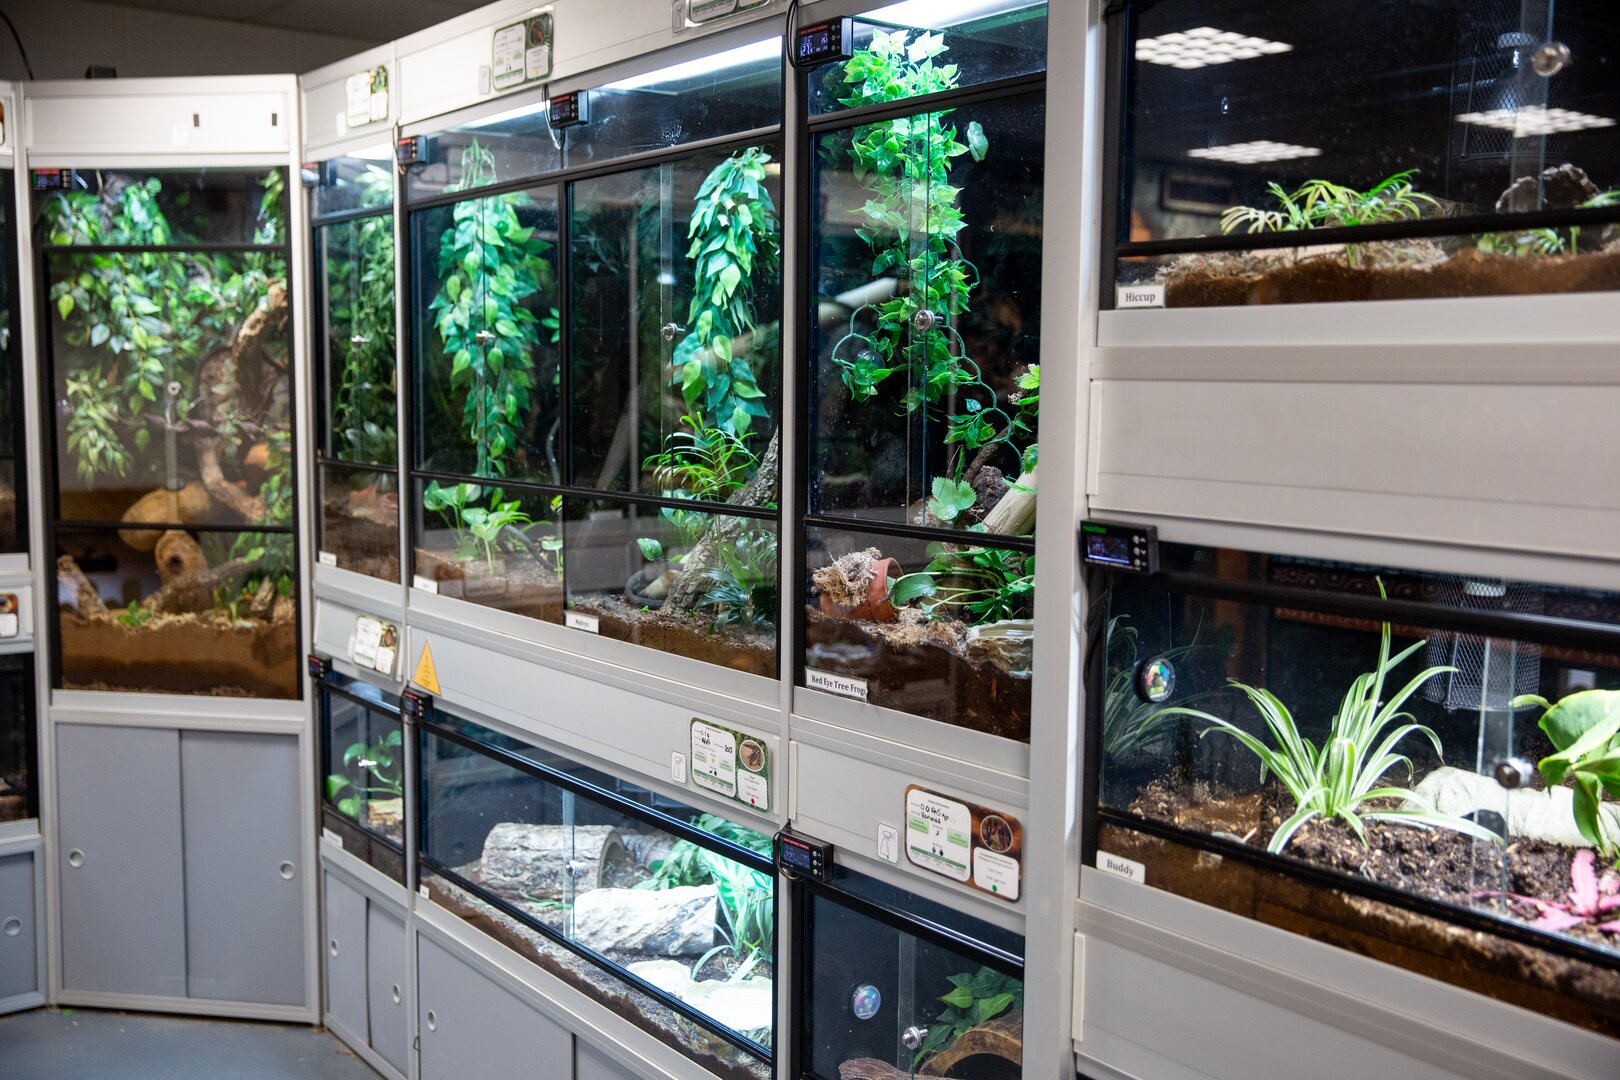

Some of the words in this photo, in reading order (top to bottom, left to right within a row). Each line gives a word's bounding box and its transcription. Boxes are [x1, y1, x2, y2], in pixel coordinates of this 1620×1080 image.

[1125, 292, 1156, 304] Hiccup
[811, 675, 823, 685] Red
[823, 677, 833, 688] Eye
[834, 680, 849, 691] Tree
[1106, 859, 1135, 877] Buddy
